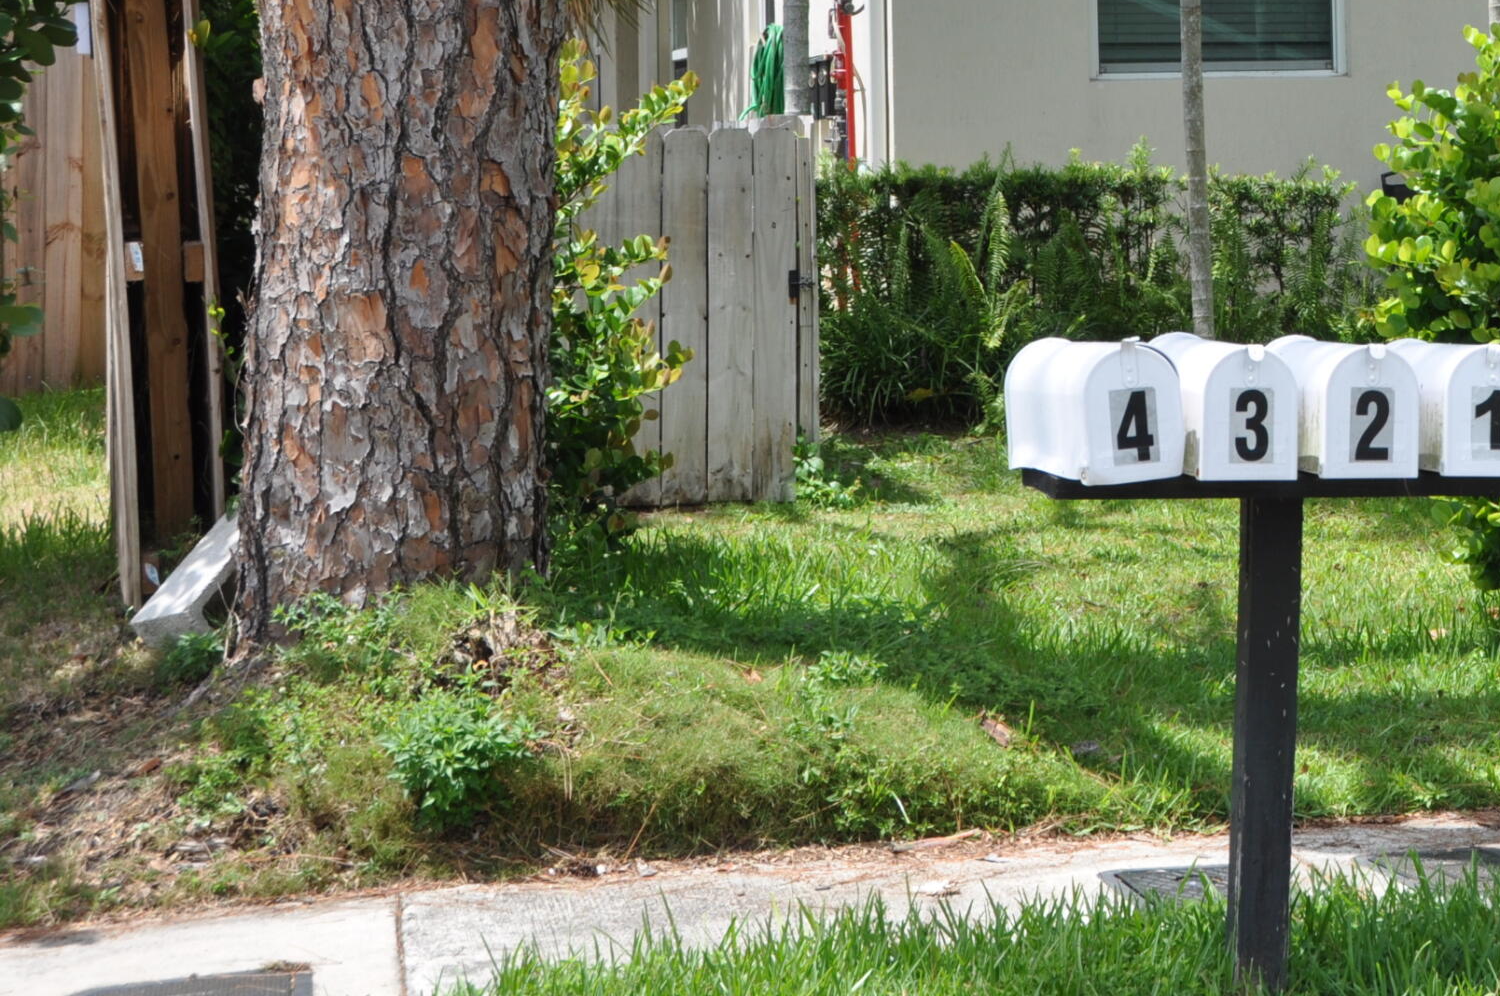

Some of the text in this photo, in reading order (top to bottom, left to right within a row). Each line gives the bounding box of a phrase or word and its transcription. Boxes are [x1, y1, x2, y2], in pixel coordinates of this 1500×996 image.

[1117, 391, 1154, 461] 4
[1235, 390, 1268, 461] 3
[1355, 390, 1389, 461] 2
